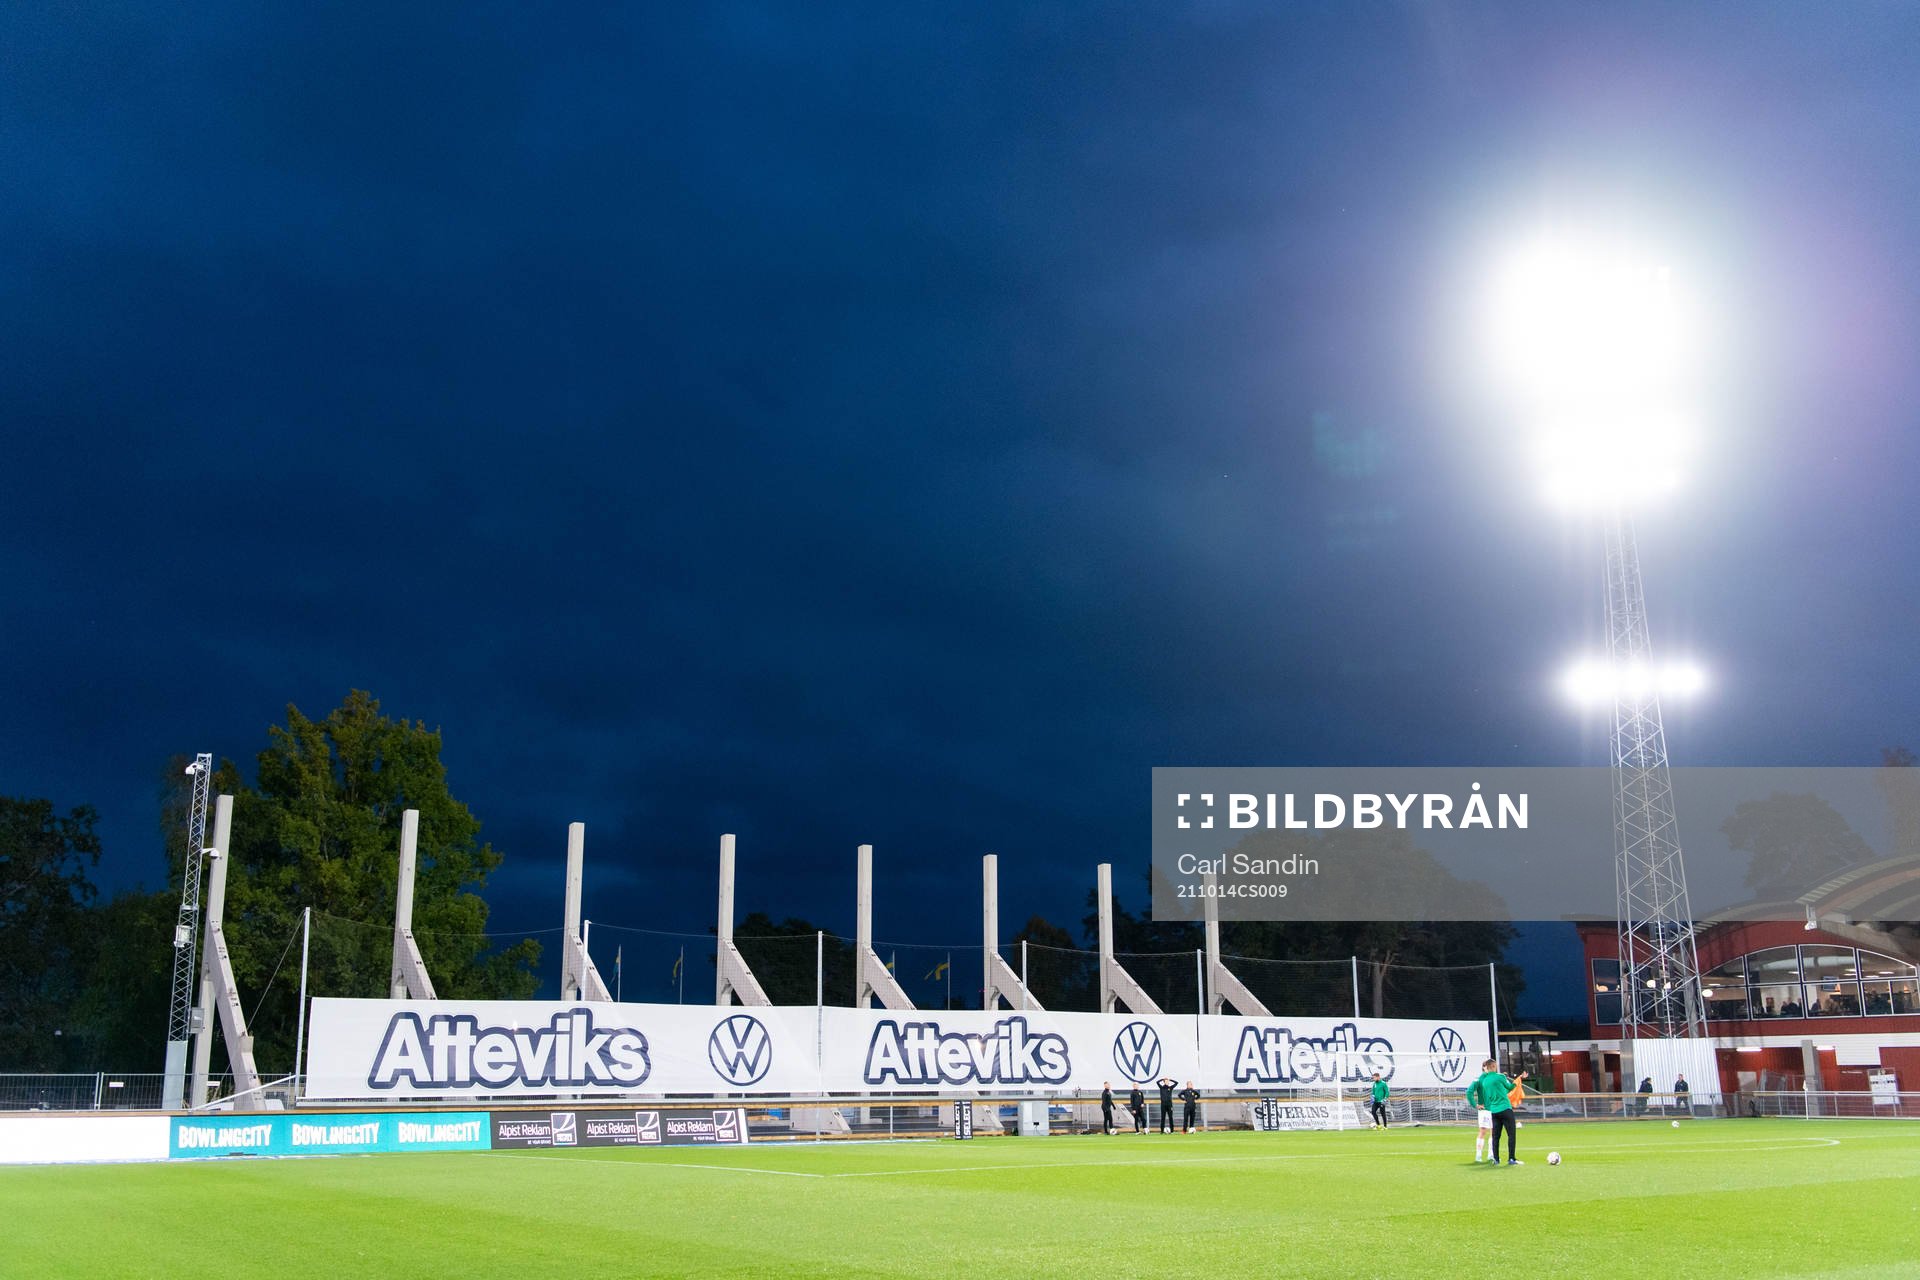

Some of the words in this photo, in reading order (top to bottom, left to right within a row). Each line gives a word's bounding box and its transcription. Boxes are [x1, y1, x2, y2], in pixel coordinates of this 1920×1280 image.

[367, 1008, 651, 1089] Atteviks
[864, 1016, 1071, 1085] Atteviks
[1232, 1022, 1395, 1084] Atteviks
[1255, 1106, 1329, 1120] SVERINS
[178, 1124, 272, 1149] BOWLINGCITY
[292, 1122, 380, 1146] BOWLINGCITY
[398, 1120, 481, 1143] BOWLINGCITY
[499, 1124, 521, 1138] Alpist
[522, 1123, 551, 1136] Reklam
[586, 1122, 607, 1135] Alpist
[608, 1121, 635, 1134] Reklam
[667, 1121, 687, 1134] Alpist
[688, 1121, 714, 1133] Reklam
